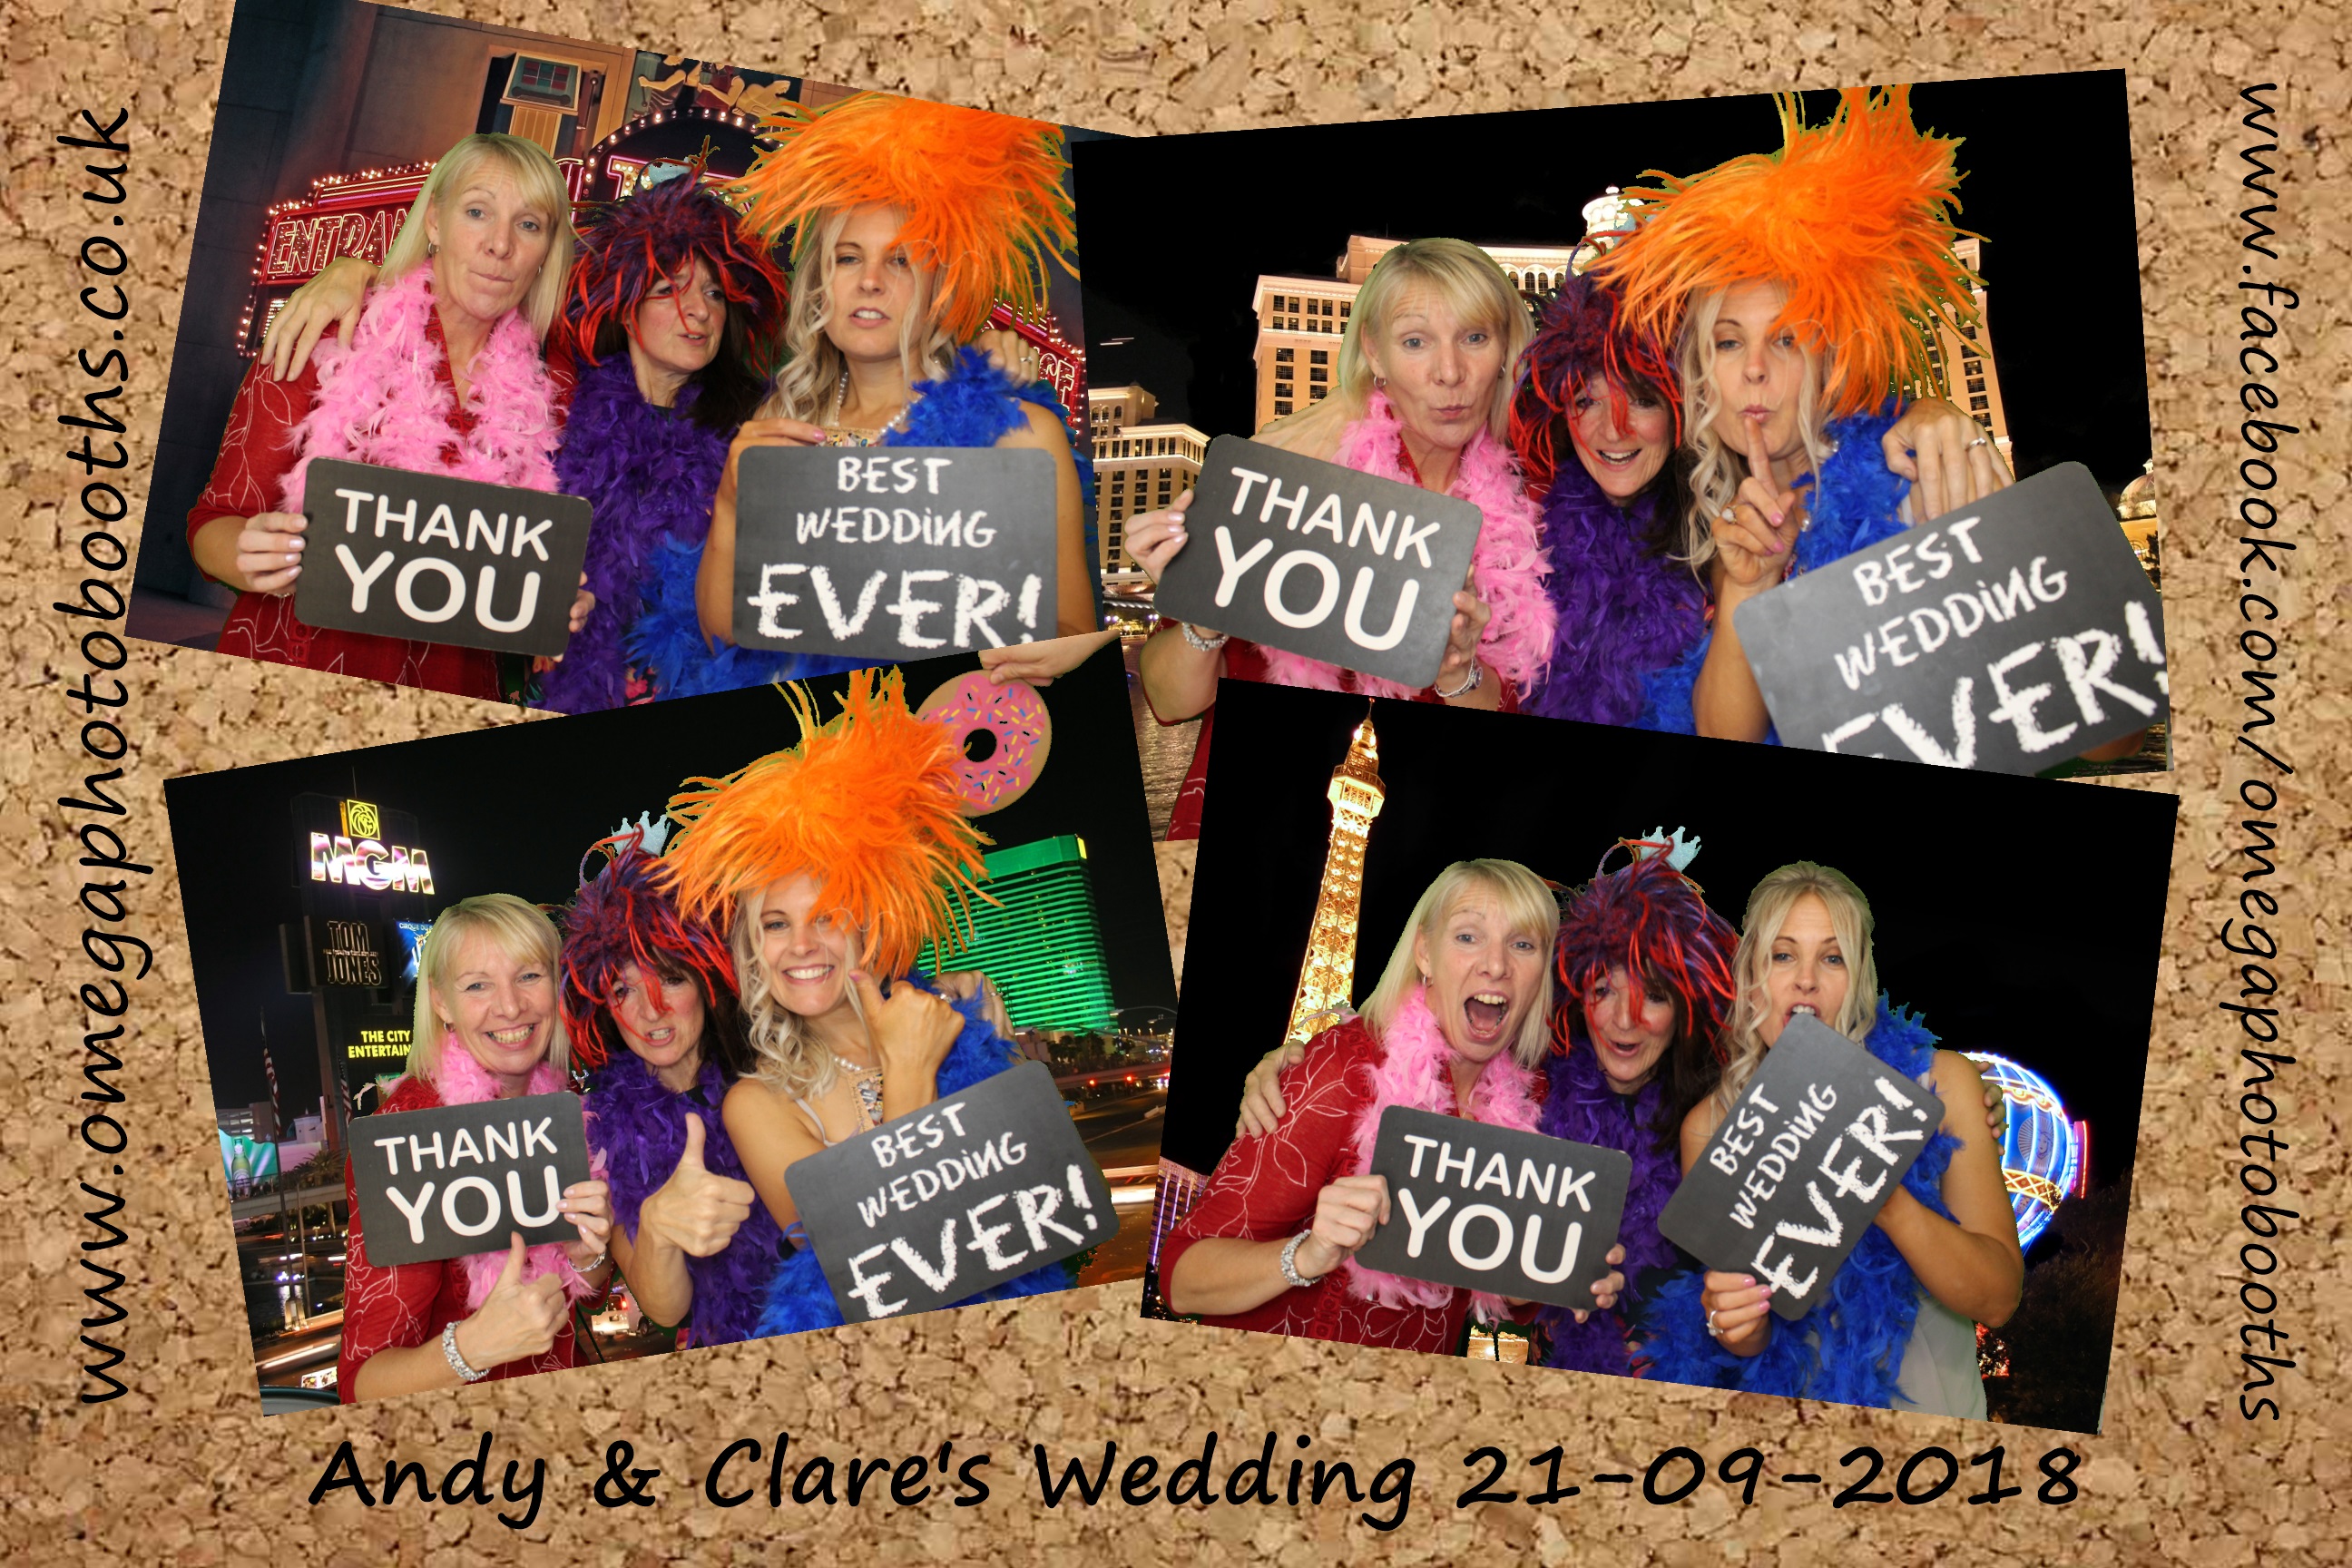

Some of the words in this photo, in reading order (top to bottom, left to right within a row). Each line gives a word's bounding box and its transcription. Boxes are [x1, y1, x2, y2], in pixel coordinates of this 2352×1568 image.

[837, 456, 953, 495] BEST
[335, 488, 553, 562] THANK
[1230, 466, 1441, 569] THANK
[335, 544, 541, 633] YOU
[1214, 525, 1419, 651] YOU
[1852, 515, 1982, 606] BEST
[747, 563, 1042, 650] EVER!
[310, 831, 436, 895] MGM
[327, 920, 370, 953] TOM
[327, 953, 382, 986] JONES
[348, 1044, 412, 1059] ENTERTAIN
[360, 1030, 385, 1043] THE
[387, 1030, 411, 1043] CITY
[374, 1116, 558, 1175] THANK
[870, 1102, 966, 1168] BEST
[1709, 1083, 1779, 1176] BEST
[386, 1164, 564, 1244] YOU
[1404, 1133, 1596, 1213] THANK
[1751, 1076, 1929, 1299] EVER!
[848, 1163, 1097, 1319] EVER!
[1397, 1188, 1583, 1284] YOU
